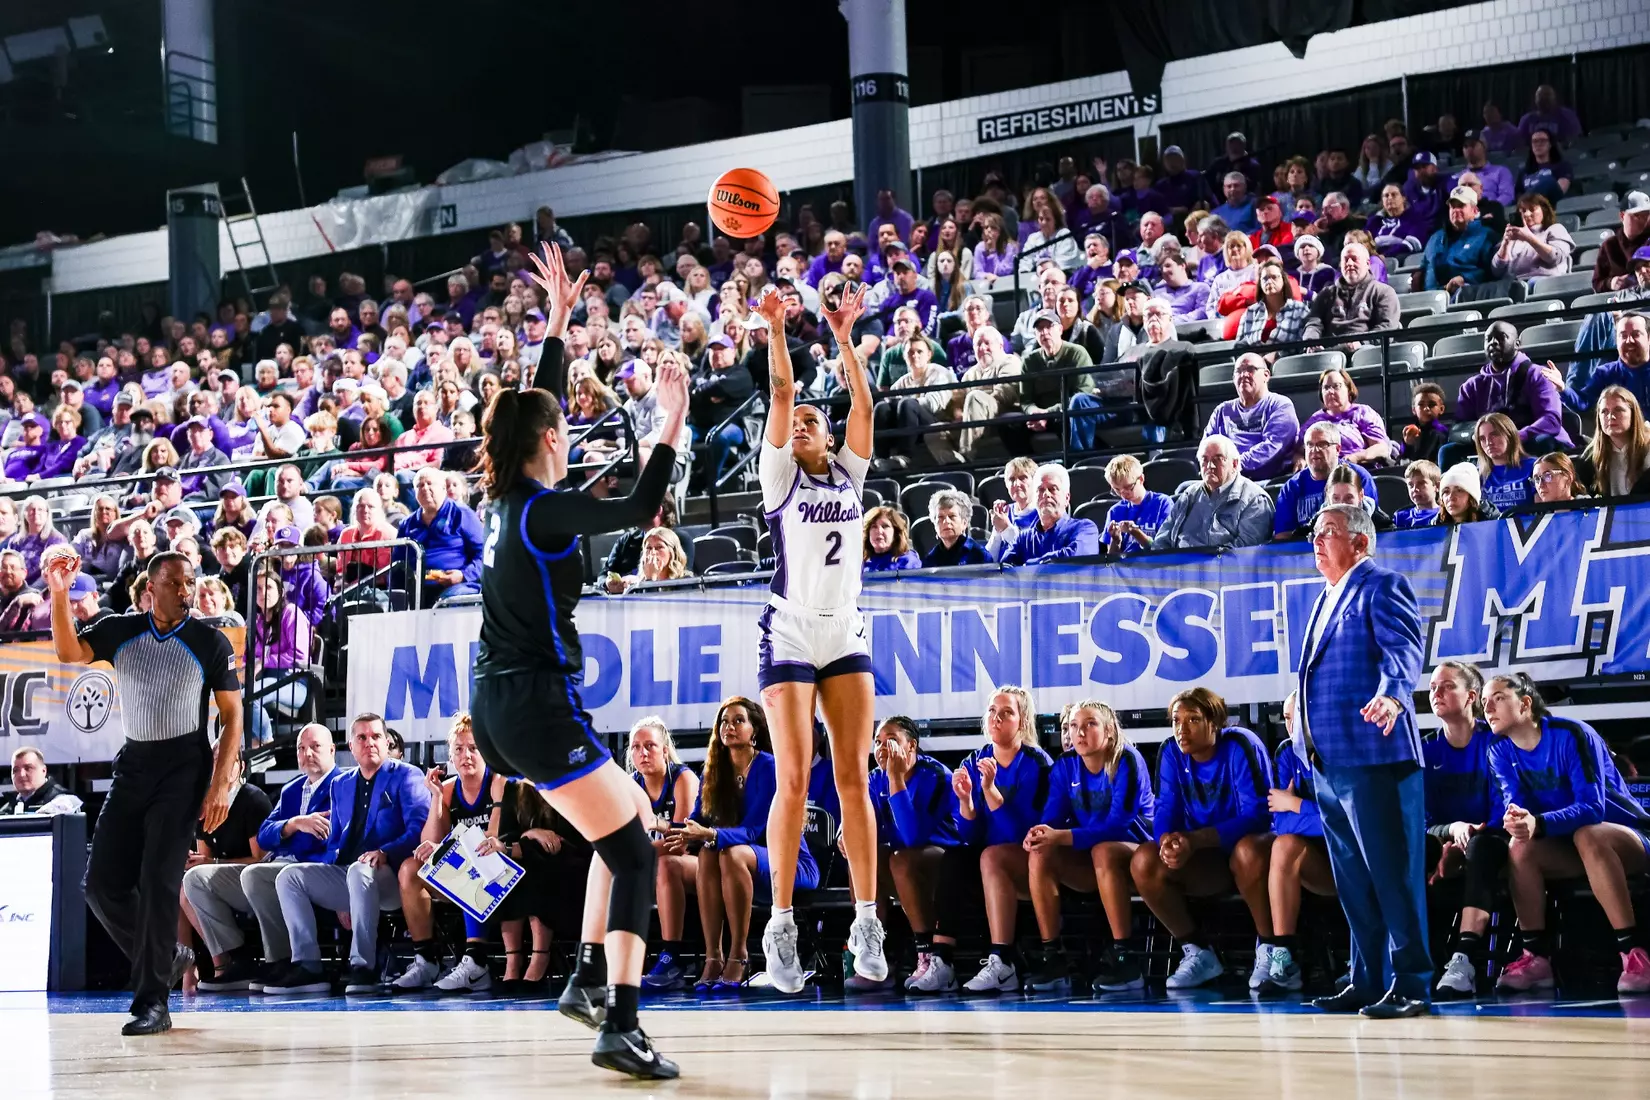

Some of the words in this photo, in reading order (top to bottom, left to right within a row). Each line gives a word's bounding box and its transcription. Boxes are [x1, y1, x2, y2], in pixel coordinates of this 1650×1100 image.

[855, 80, 877, 98] 116
[981, 94, 1157, 140] REFRESHMENTS
[717, 190, 760, 212] Wilson
[798, 501, 859, 523] Wildcats
[825, 530, 842, 566] 2
[384, 625, 721, 721] MDLE
[870, 580, 1325, 697] NNESSE
